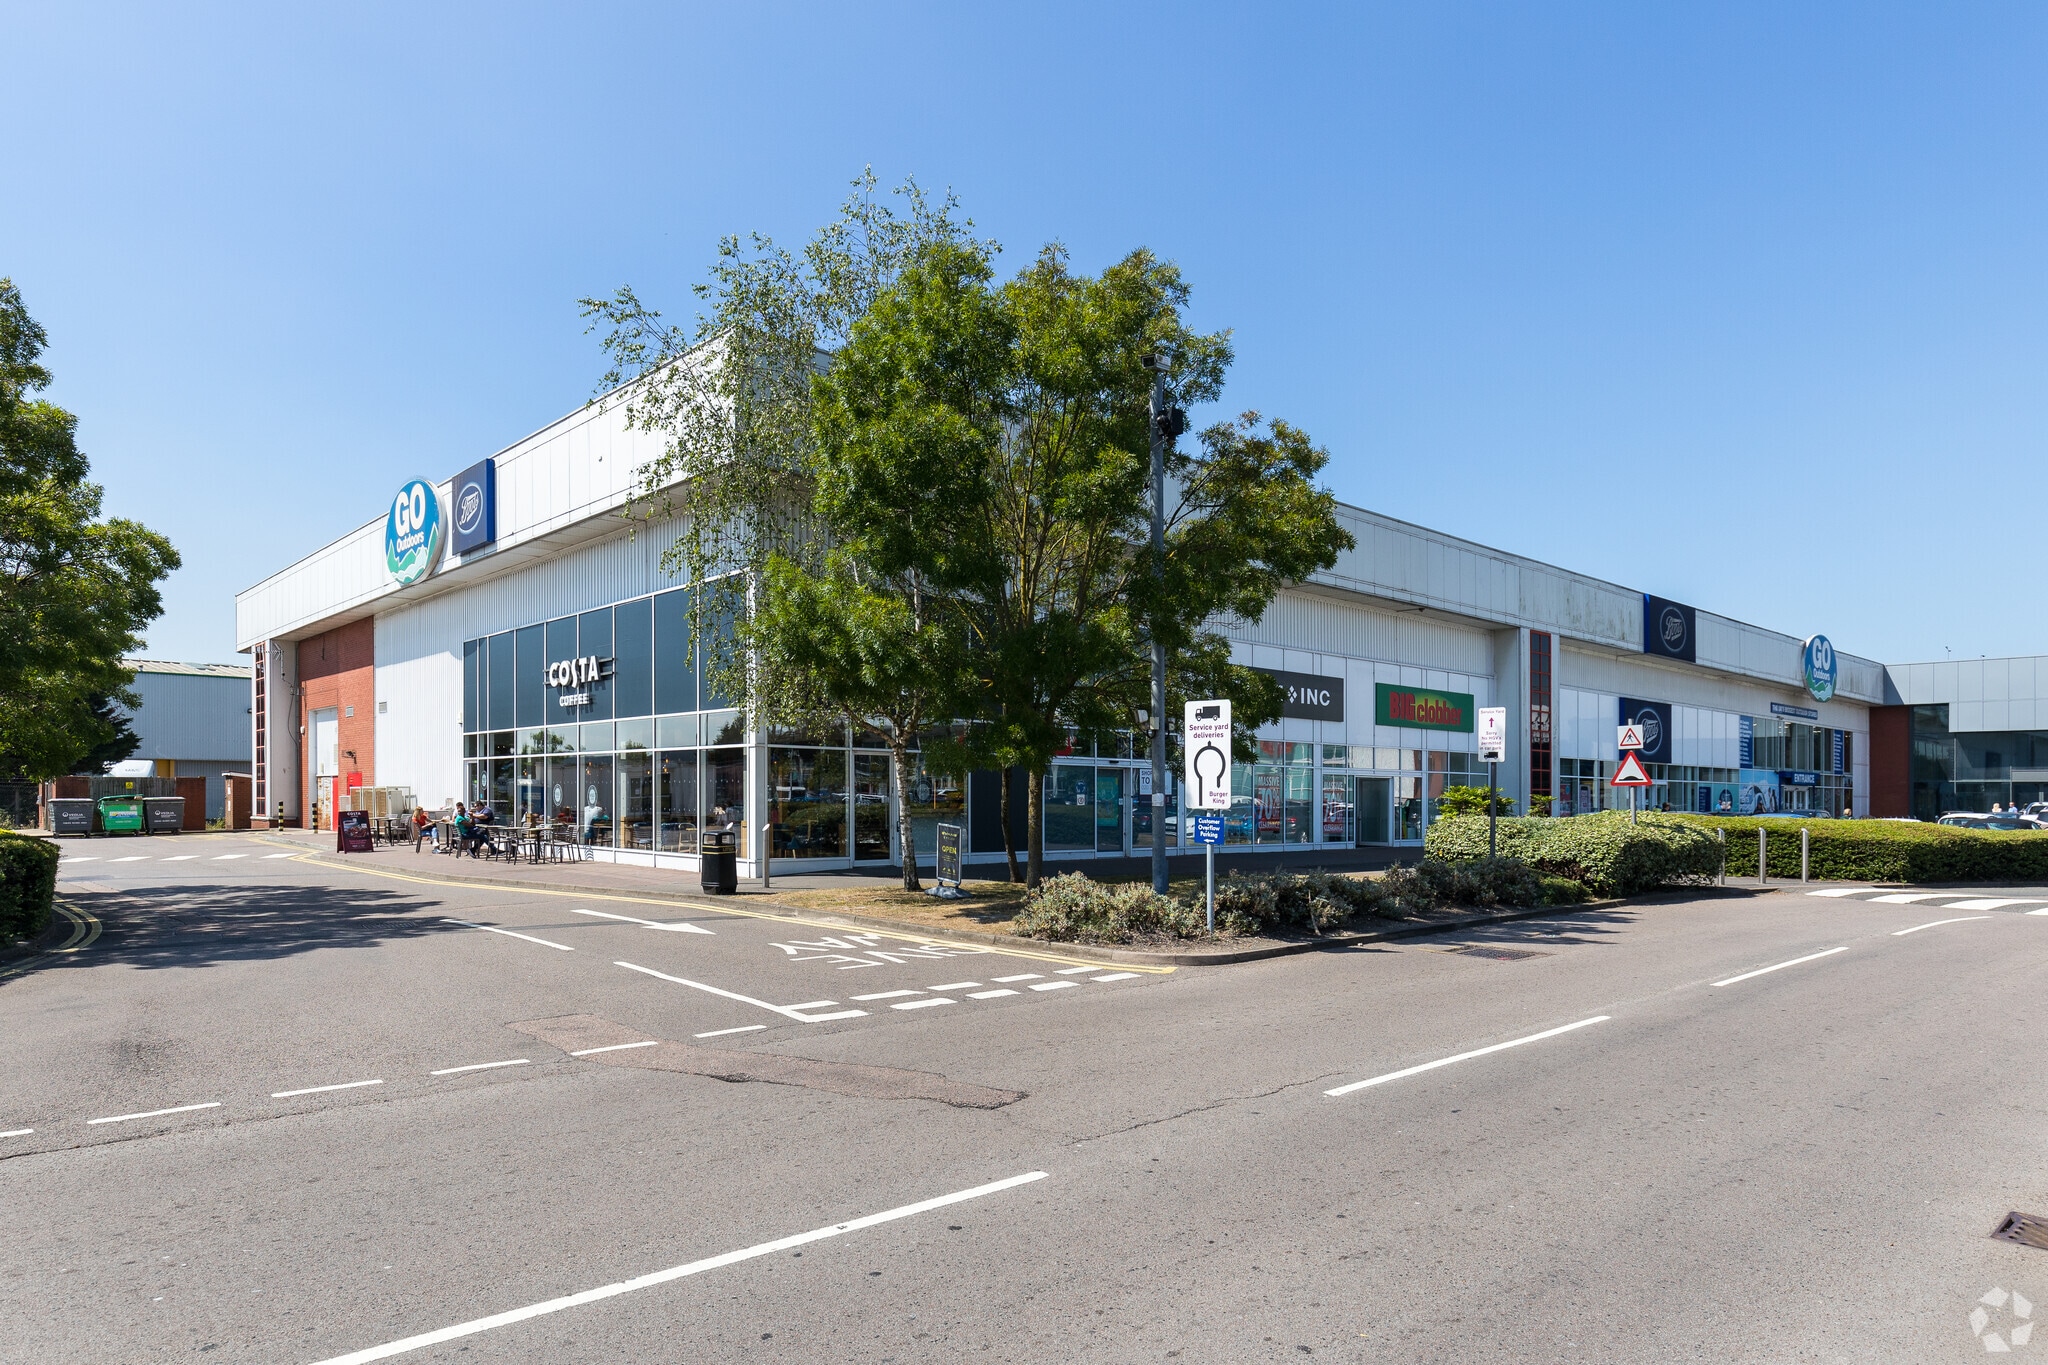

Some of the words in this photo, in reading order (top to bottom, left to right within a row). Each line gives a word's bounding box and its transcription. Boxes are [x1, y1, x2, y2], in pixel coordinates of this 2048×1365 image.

[394, 483, 426, 537] GO
[459, 491, 479, 525] Boots
[396, 531, 425, 553] Outdoors
[1664, 615, 1683, 641] Boots
[1812, 638, 1831, 671] GO
[549, 655, 599, 688] COSTA
[1813, 667, 1831, 681] Outdoors
[559, 693, 590, 707] COFFEE
[1301, 687, 1331, 707] INC
[1389, 691, 1416, 721] BIG
[1417, 698, 1462, 726] clobber
[1214, 723, 1229, 731] yard
[1141, 777, 1151, 785] TO
[1258, 776, 1280, 786] MASSIVE
[1794, 773, 1815, 783] ENTRANCE
[1209, 791, 1228, 799] Burger
[1200, 831, 1219, 839] Parking
[942, 845, 957, 854] OPEN
